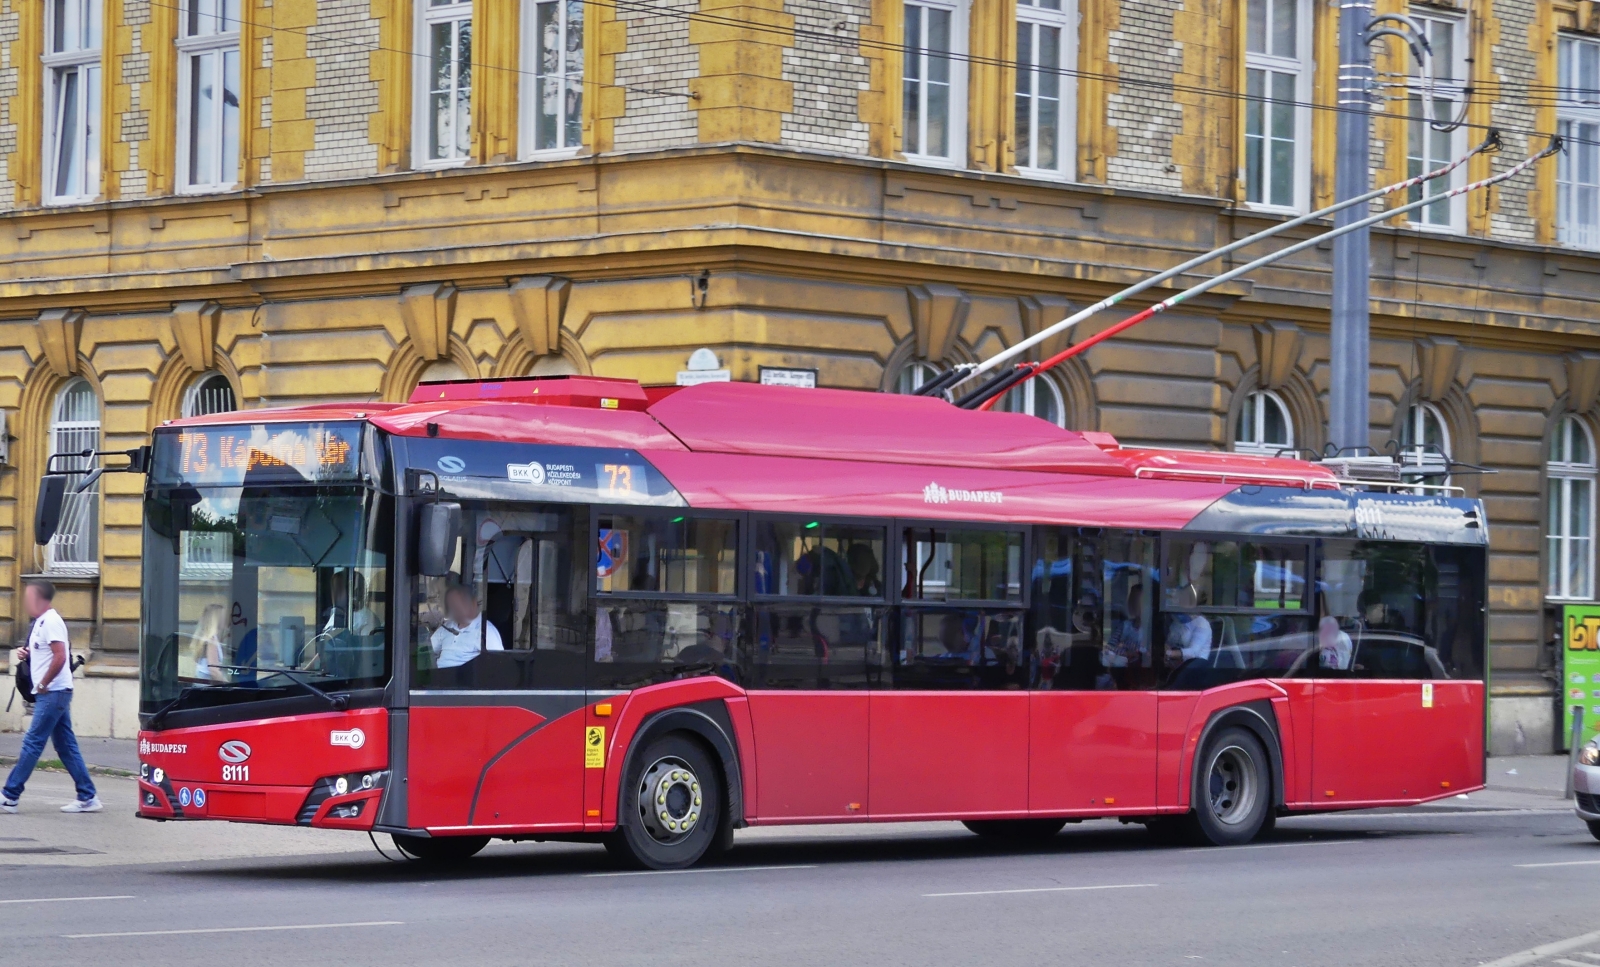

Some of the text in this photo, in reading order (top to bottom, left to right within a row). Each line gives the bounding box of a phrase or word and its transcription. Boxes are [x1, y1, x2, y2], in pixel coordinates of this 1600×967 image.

[178, 432, 350, 473] 73 Kápolna tér
[512, 469, 529, 477] BKK
[604, 464, 631, 497] 73
[948, 489, 1003, 503] BUDAPEST
[1355, 507, 1382, 524] 8111
[335, 734, 349, 742] BKK
[151, 743, 188, 754] BUDAPEST
[222, 765, 249, 781] 8111
